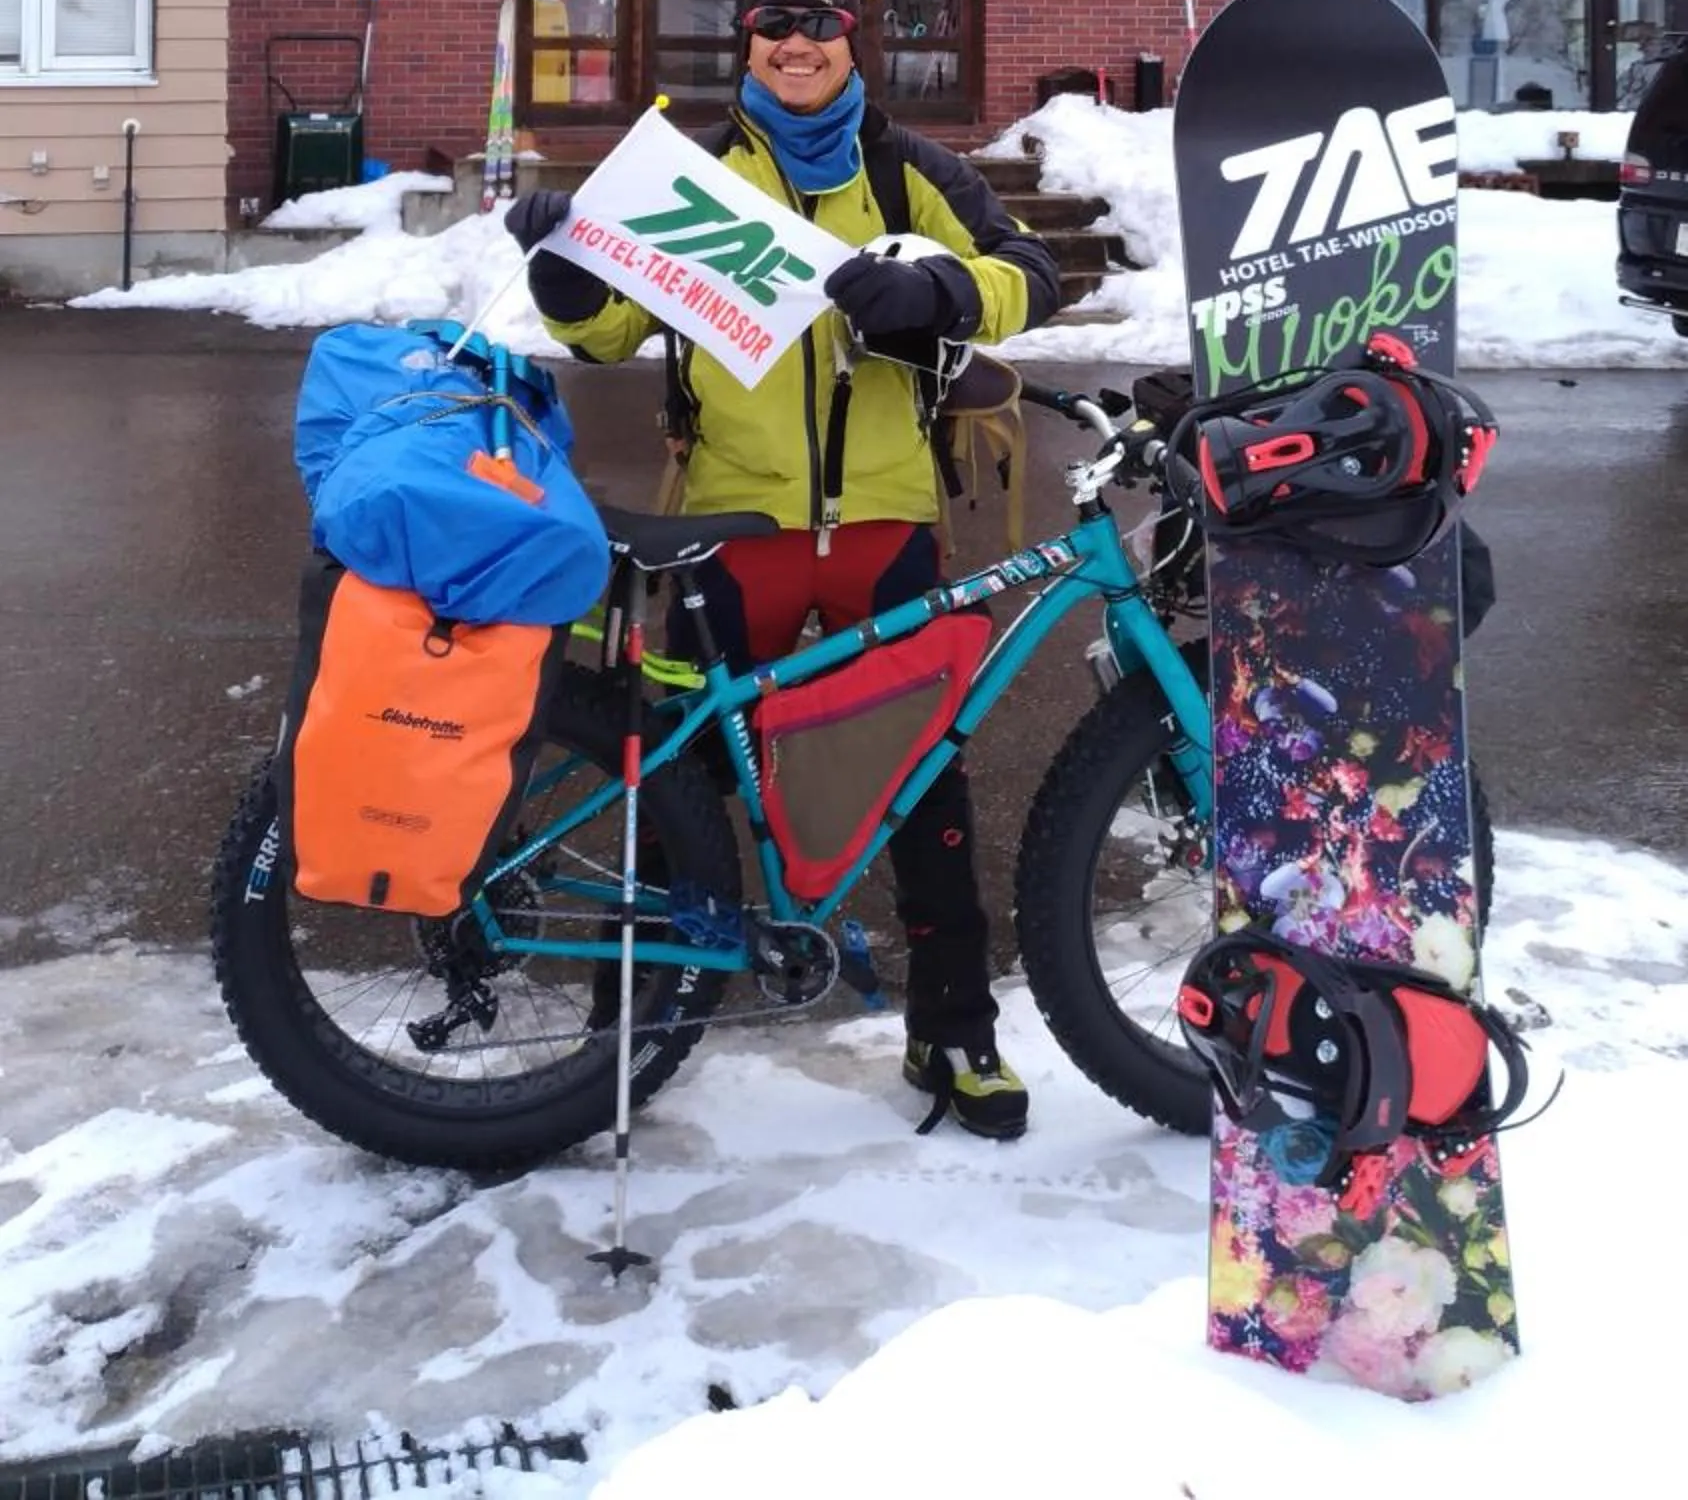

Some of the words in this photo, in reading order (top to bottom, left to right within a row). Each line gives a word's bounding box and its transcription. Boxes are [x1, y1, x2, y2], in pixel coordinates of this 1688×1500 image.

[1220, 97, 1457, 260] TAE
[1219, 251, 1297, 286] HOTEL
[1191, 276, 1288, 338] TPSS
[244, 815, 280, 904] TERRE
